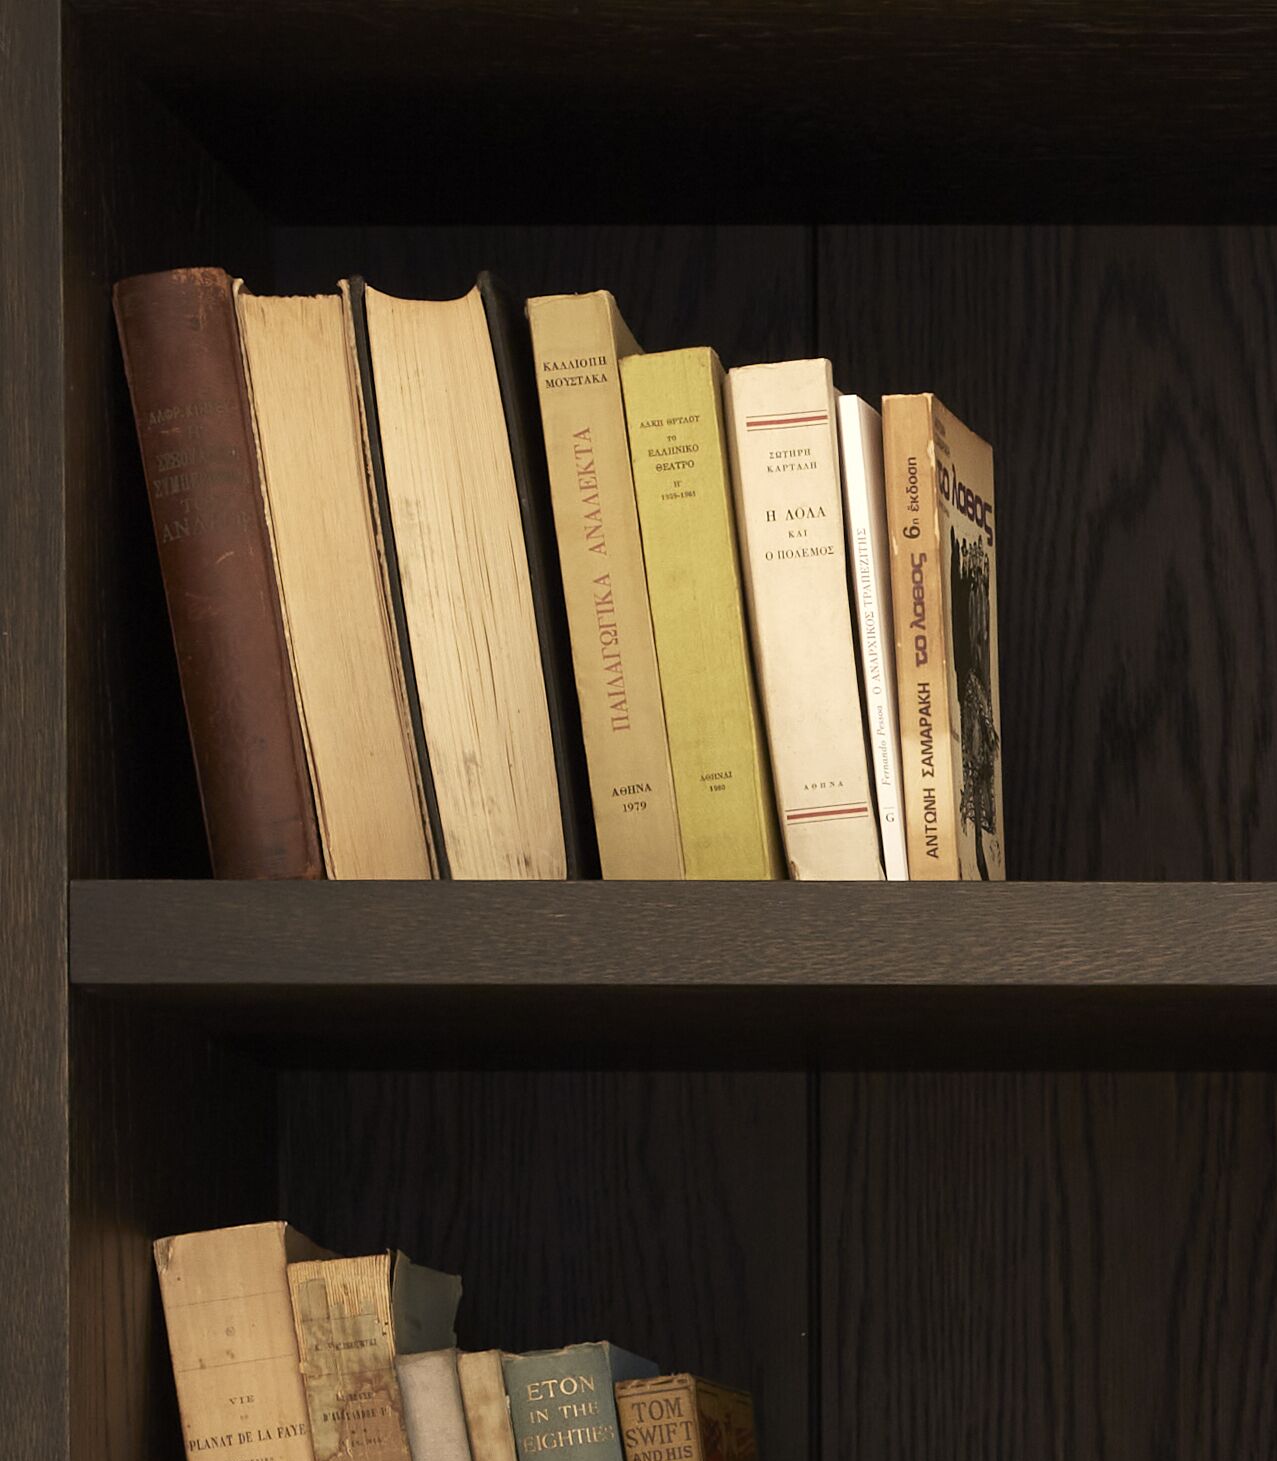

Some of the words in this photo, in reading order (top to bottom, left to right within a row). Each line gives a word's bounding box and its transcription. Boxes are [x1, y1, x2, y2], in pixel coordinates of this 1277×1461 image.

[545, 373, 608, 389] ΜΟΥΣΤΑΚΑ
[769, 448, 811, 459] ΣΩΤΗΡΗ
[656, 460, 695, 472] ΘΕΑΤΡΟ
[767, 462, 817, 473] ΚΑΡΤΑΛΗ
[573, 427, 607, 556] ΑΝΑΛΕΚΤΑ
[766, 510, 776, 522] Η
[785, 506, 826, 521] ΛΟΛΑ
[788, 529, 808, 539] ΚΑΙ
[765, 551, 774, 561] Ο
[778, 545, 834, 560] ΠΟΛΕΜΟΣ
[594, 573, 630, 732] ΠΑΙΔΑΓΩΓΙΚΑ
[918, 682, 934, 778] ΣΑΜΑΡΑΚΗ
[611, 783, 652, 797] ΑΘΗΝΑ
[623, 801, 647, 813] 1979
[924, 788, 939, 858] ΑΝΤΩΝΗ
[527, 1375, 595, 1401] ETON
[229, 1395, 255, 1405] VIE
[529, 1410, 549, 1424] IN
[558, 1402, 600, 1419] THE
[632, 1397, 684, 1423] TOM
[189, 1435, 233, 1452] PLANAT
[238, 1431, 253, 1445] DE
[258, 1429, 272, 1440] LA
[277, 1423, 306, 1439] FAYE
[523, 1425, 614, 1453] EIGHTIES
[625, 1420, 693, 1449] SWIFT
[666, 1446, 693, 1461] HIS
